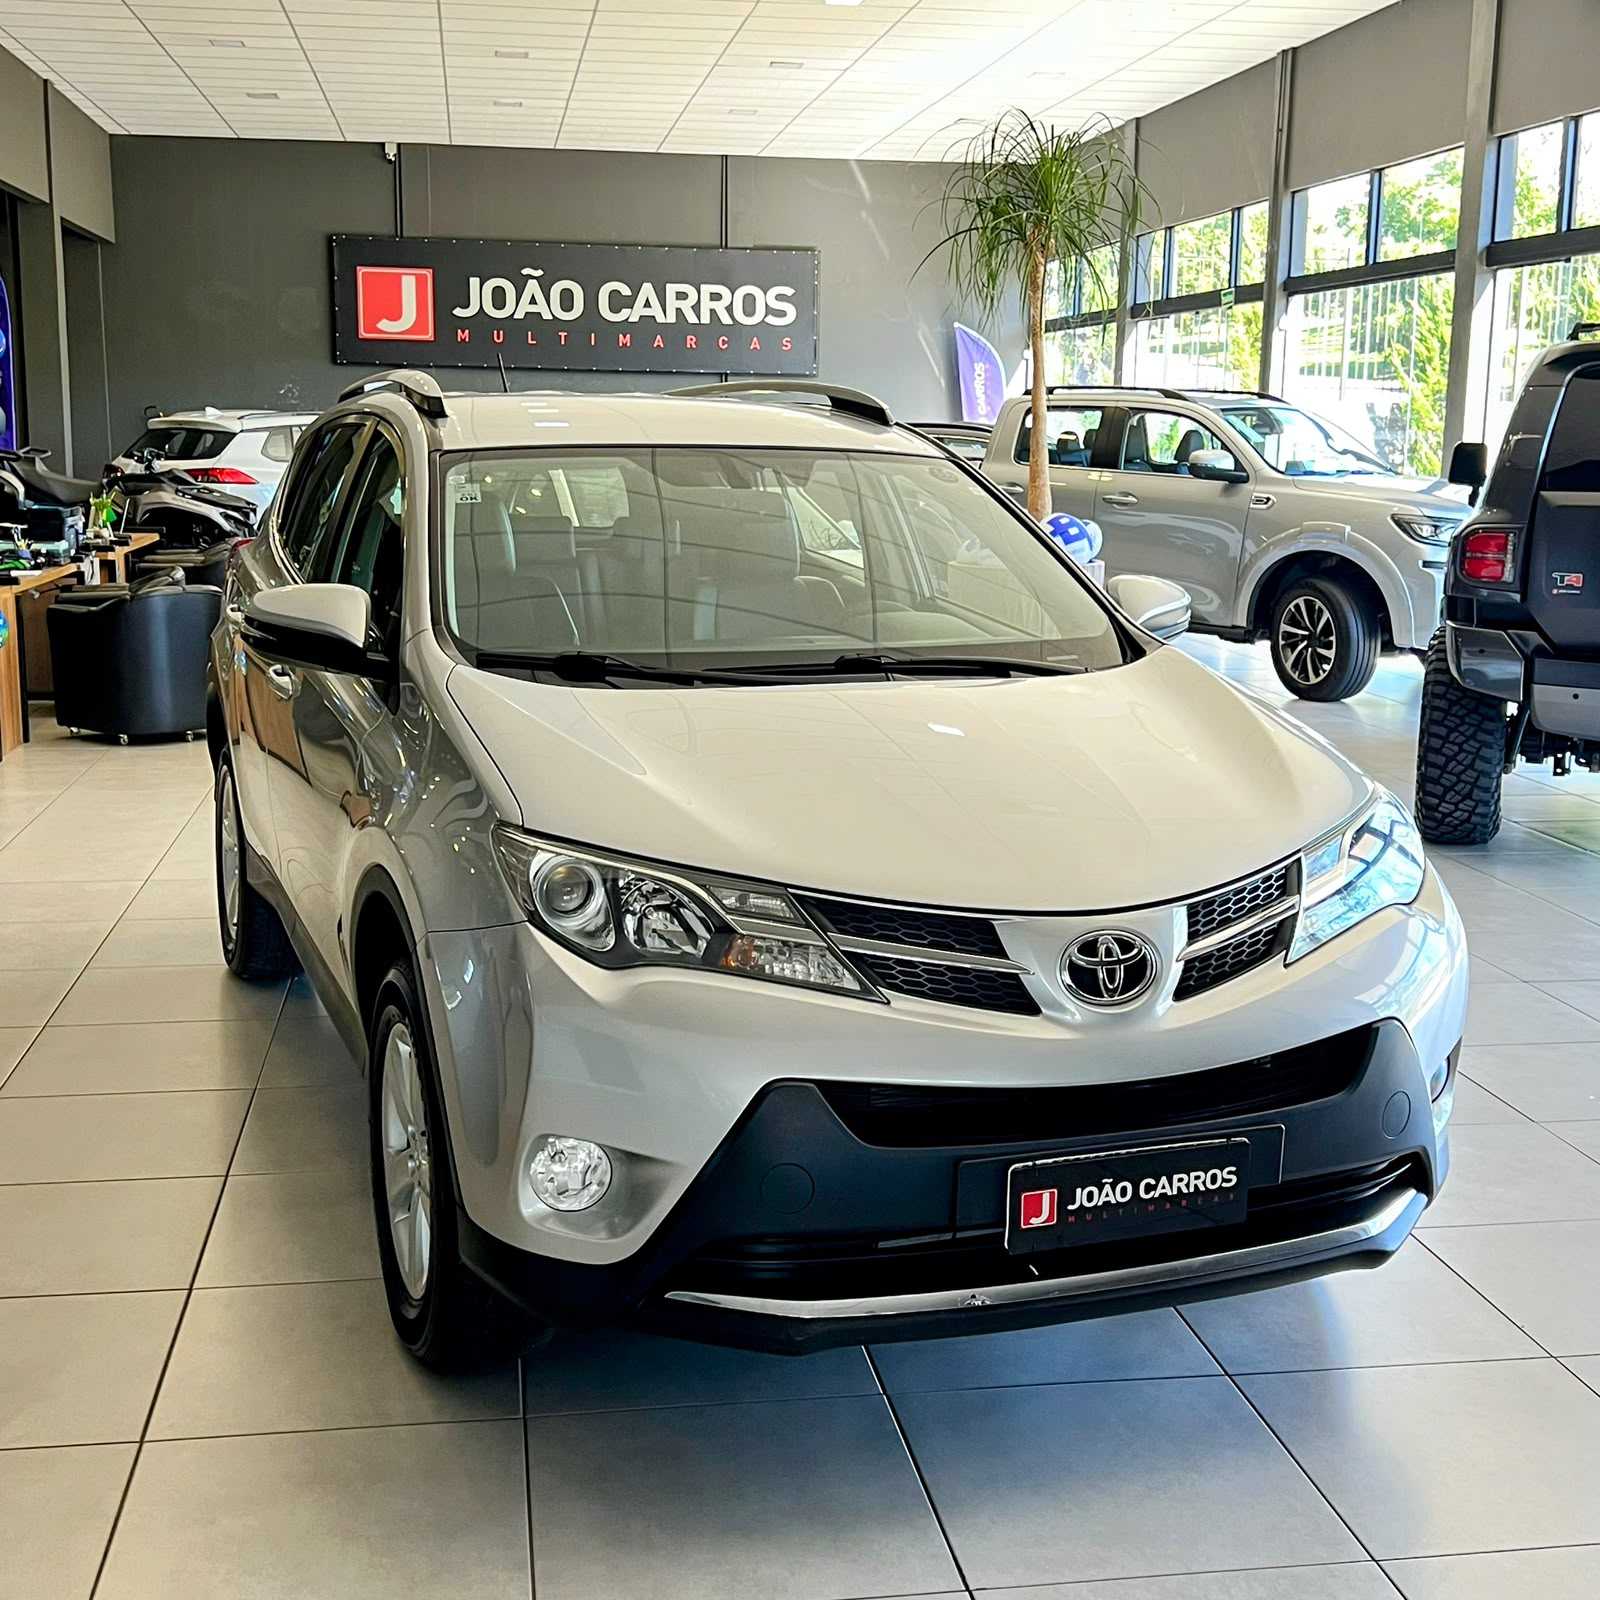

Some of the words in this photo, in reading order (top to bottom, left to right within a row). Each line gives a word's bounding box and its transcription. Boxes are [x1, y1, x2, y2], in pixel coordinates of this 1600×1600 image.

[376, 275, 417, 332] J
[452, 267, 585, 321] JOÃO
[598, 281, 797, 326] CARROS
[456, 328, 793, 350] MULTIMARCAS
[1029, 1192, 1050, 1224] J
[1067, 1178, 1132, 1210] JOÃO
[1139, 1166, 1237, 1200] CARROS
